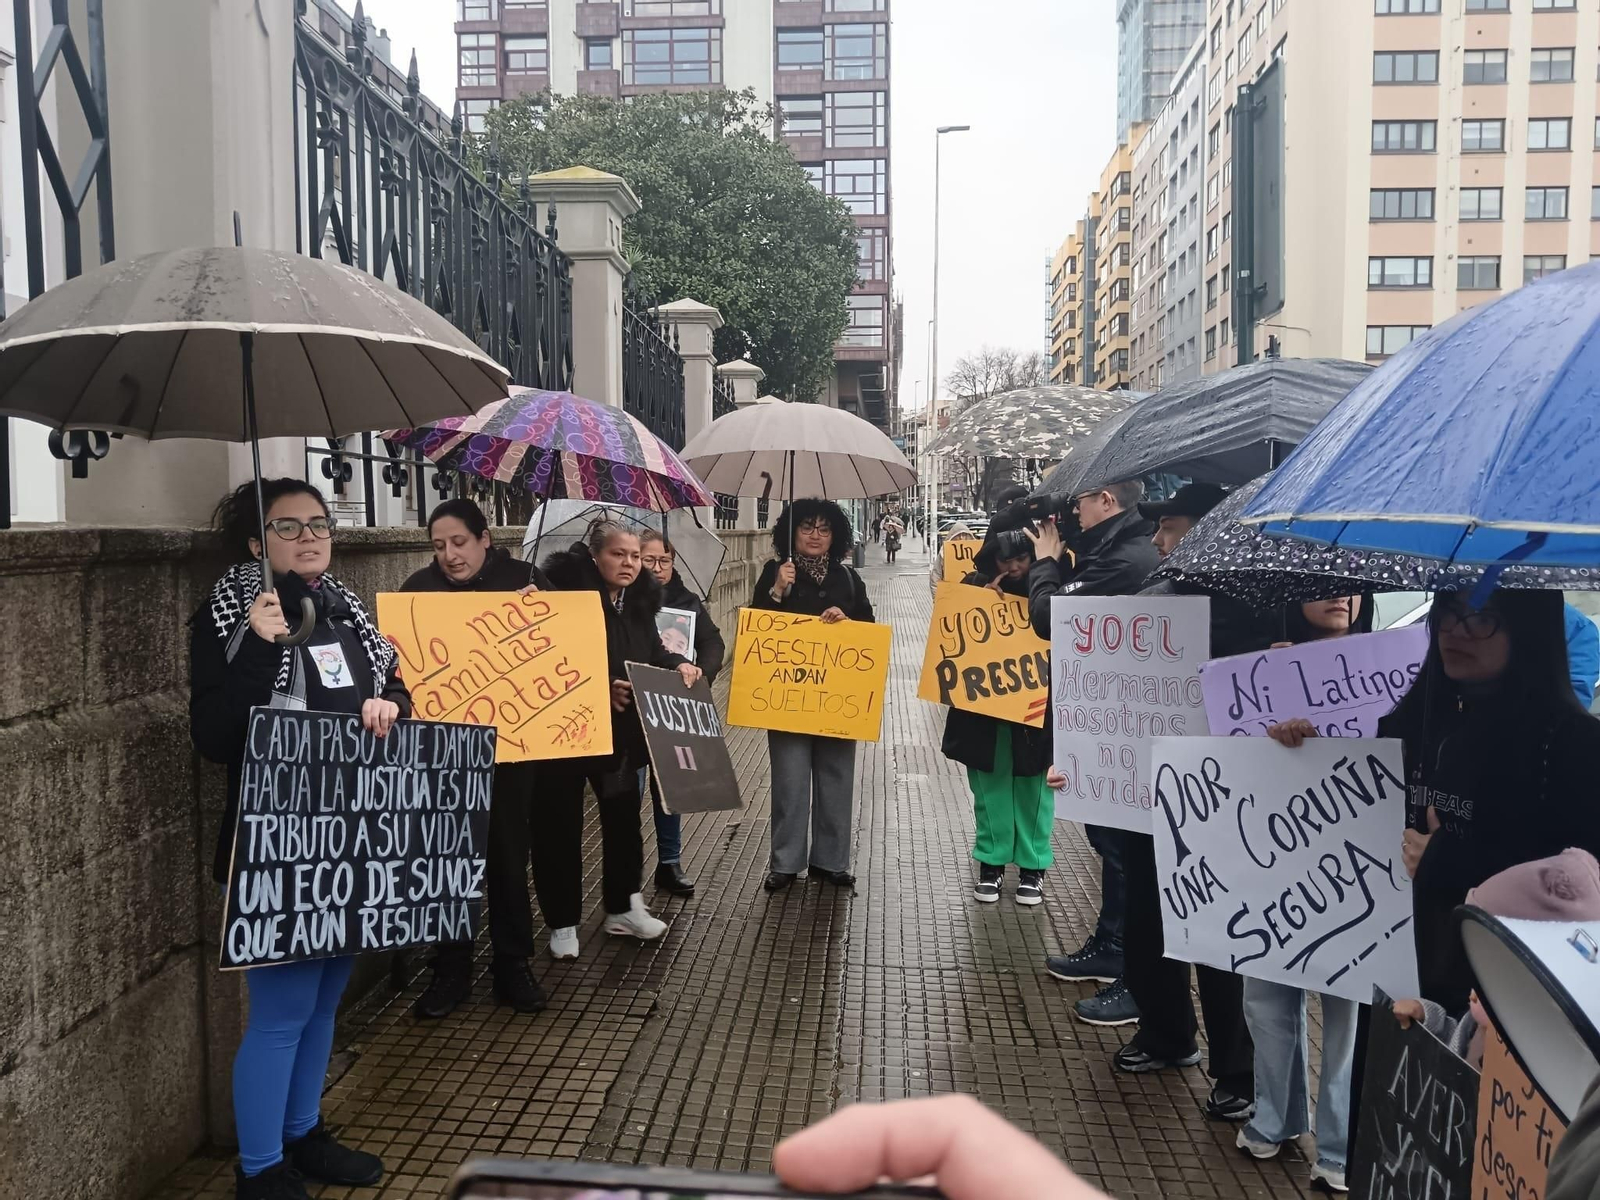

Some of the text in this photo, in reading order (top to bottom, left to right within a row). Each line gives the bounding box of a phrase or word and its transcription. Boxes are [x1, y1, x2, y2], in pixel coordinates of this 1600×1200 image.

[740, 611, 788, 636] ¡LOS
[939, 601, 1030, 658] YOEL
[1070, 613, 1185, 662] YOEL
[410, 627, 551, 720] familias
[743, 637, 875, 671] ASESINOS
[768, 667, 828, 685] ANDAN
[1054, 659, 1203, 708] Hermano
[1228, 654, 1422, 720] Ni Latinos
[250, 714, 495, 769] CADA PASO QUE DAMOS
[643, 691, 724, 738] JUSTICIA
[1056, 702, 1187, 738] nosotros
[1099, 742, 1137, 769] no
[243, 763, 491, 812] HACIA LA JUSTICIA ES UN
[1154, 757, 1231, 866] POR
[1237, 753, 1407, 869] CORUÑA
[243, 814, 347, 864] TRIBUTO
[352, 816, 373, 858] A
[376, 812, 410, 858] SU
[238, 868, 284, 914] UN
[294, 861, 354, 912] ECO
[363, 860, 405, 907] DE
[1164, 856, 1229, 920] UNA
[1226, 839, 1405, 973] SEGURA
[228, 914, 286, 964] QUE
[357, 902, 473, 949] RESUENA
[1388, 1045, 1467, 1167] AYER
[1491, 1078, 1554, 1169] por ti
[1481, 1120, 1538, 1200] desc
